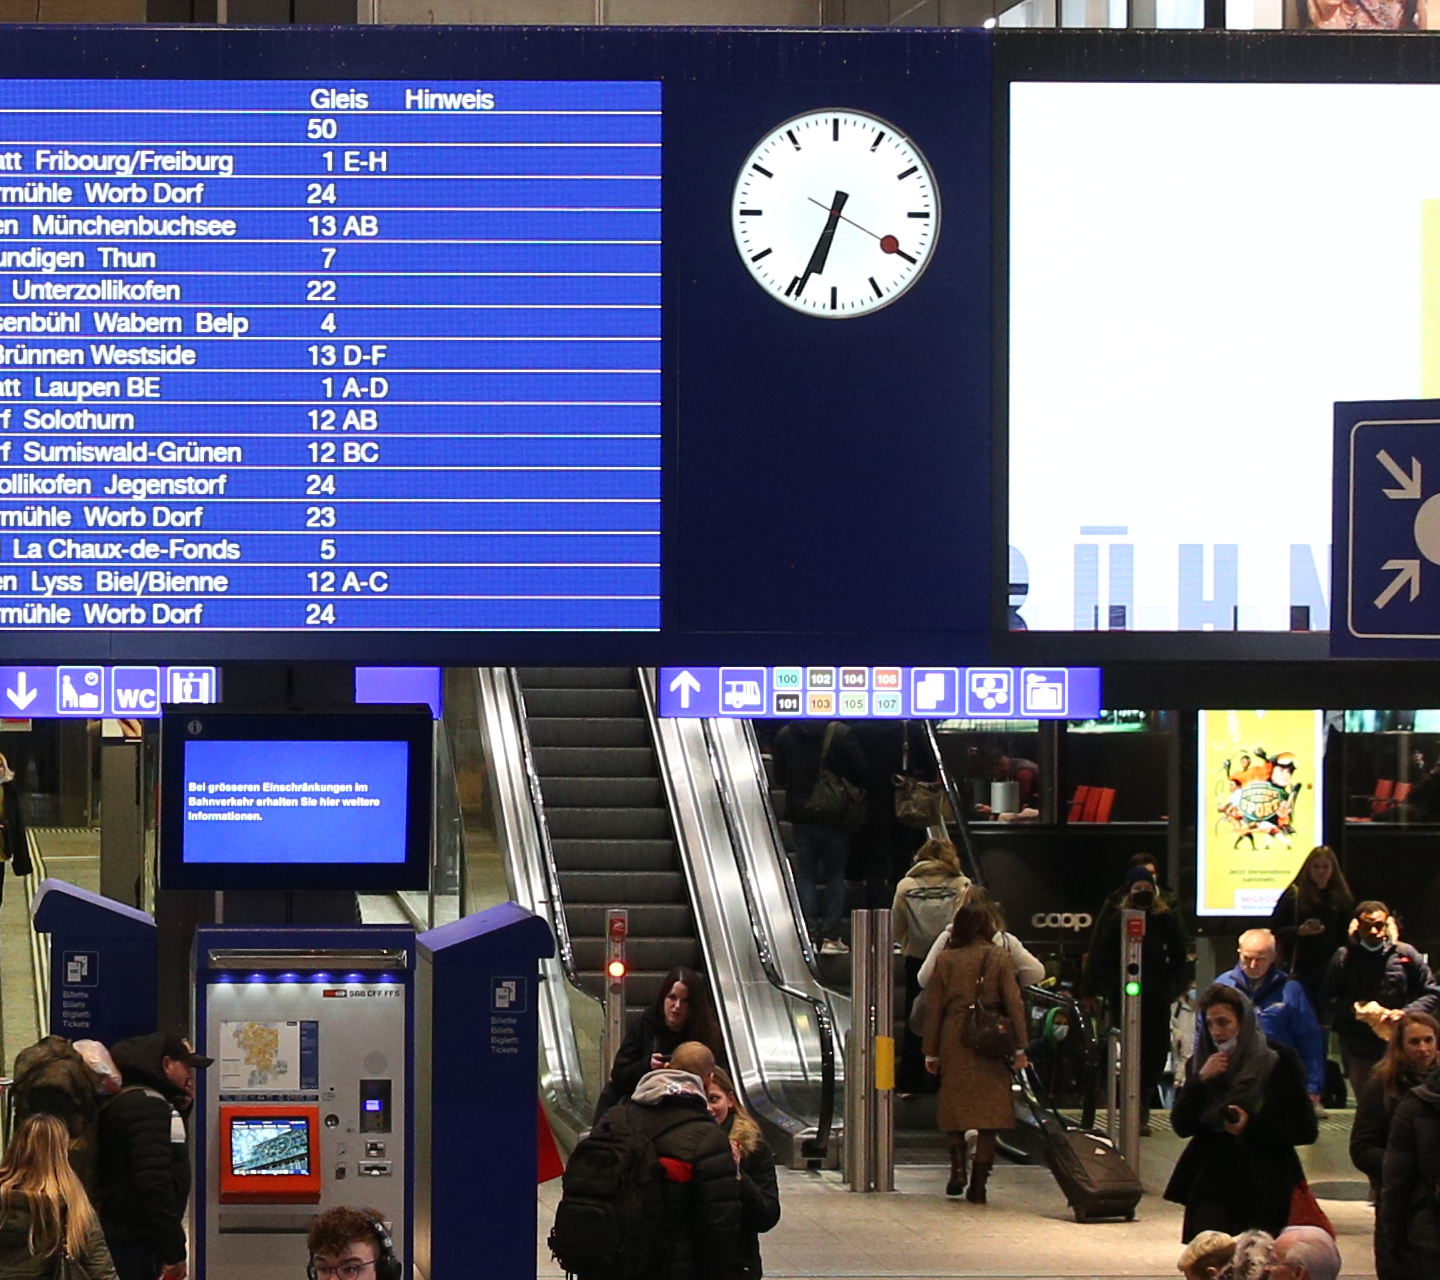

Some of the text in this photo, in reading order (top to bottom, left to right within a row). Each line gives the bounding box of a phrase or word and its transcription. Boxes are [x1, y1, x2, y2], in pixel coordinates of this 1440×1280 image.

[307, 118, 337, 139] 50
[32, 214, 237, 236] Münchenbuchsee
[308, 215, 337, 237] 13
[342, 215, 379, 237] AB
[90, 344, 198, 366] Westside
[308, 344, 337, 366] 13
[343, 344, 387, 366] D-F
[13, 538, 43, 559] La
[47, 537, 241, 560] Chaux-de-Fonds
[320, 538, 336, 560] 5
[778, 674, 898, 685] 100 102 104 106
[116, 689, 157, 709] WC
[778, 699, 897, 710] 101 103 105 107
[188, 781, 369, 795] Bei grösseren Einschränkungen im
[188, 796, 381, 808] Bahnverkehr erhalten Sie hier weitere
[188, 811, 264, 822] Informationen.
[1031, 912, 1093, 933] coop
[366, 990, 383, 998] CFF
[383, 990, 401, 998] FFS
